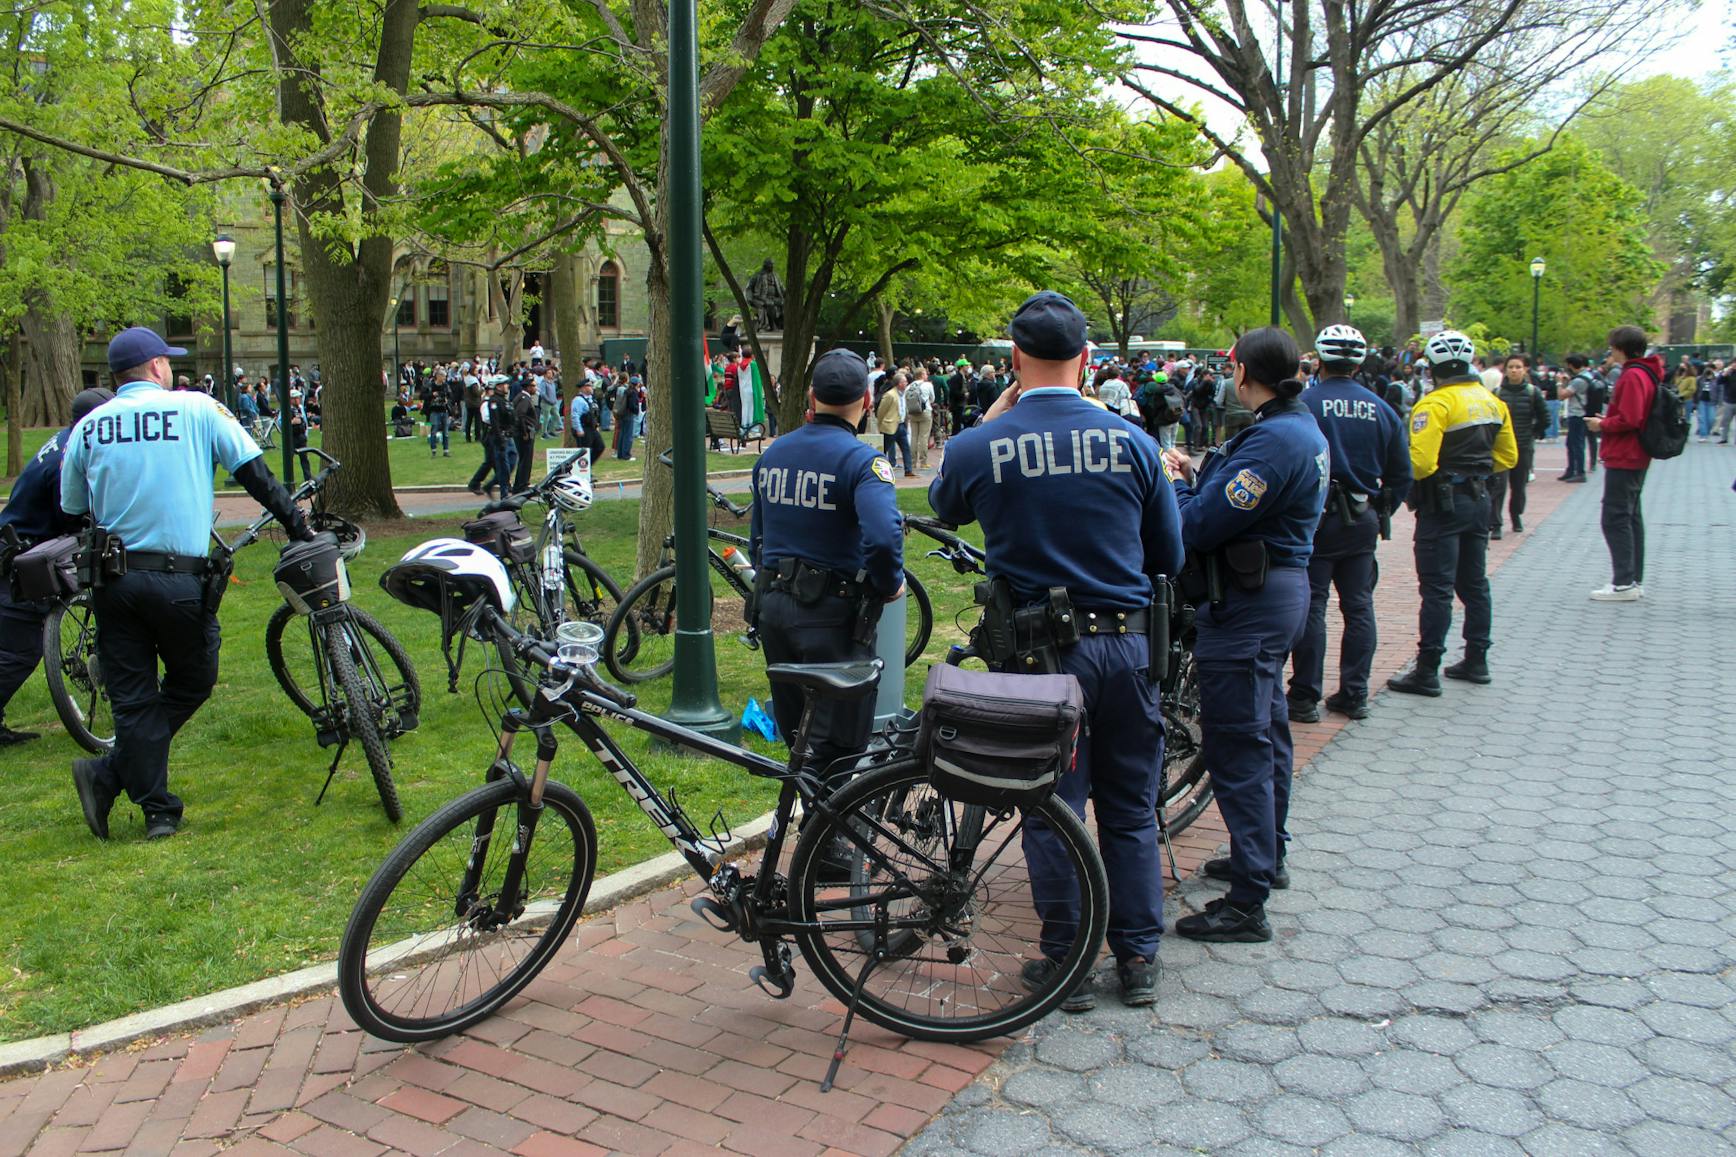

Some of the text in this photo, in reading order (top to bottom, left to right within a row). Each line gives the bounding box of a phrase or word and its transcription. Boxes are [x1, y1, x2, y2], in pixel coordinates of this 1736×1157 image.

[82, 411, 179, 449] POLICE
[1322, 399, 1377, 421] POLICE
[989, 429, 1131, 484] POLICE
[758, 467, 837, 511] POLICE
[581, 701, 635, 726] POLICE
[594, 738, 701, 860] TREK
